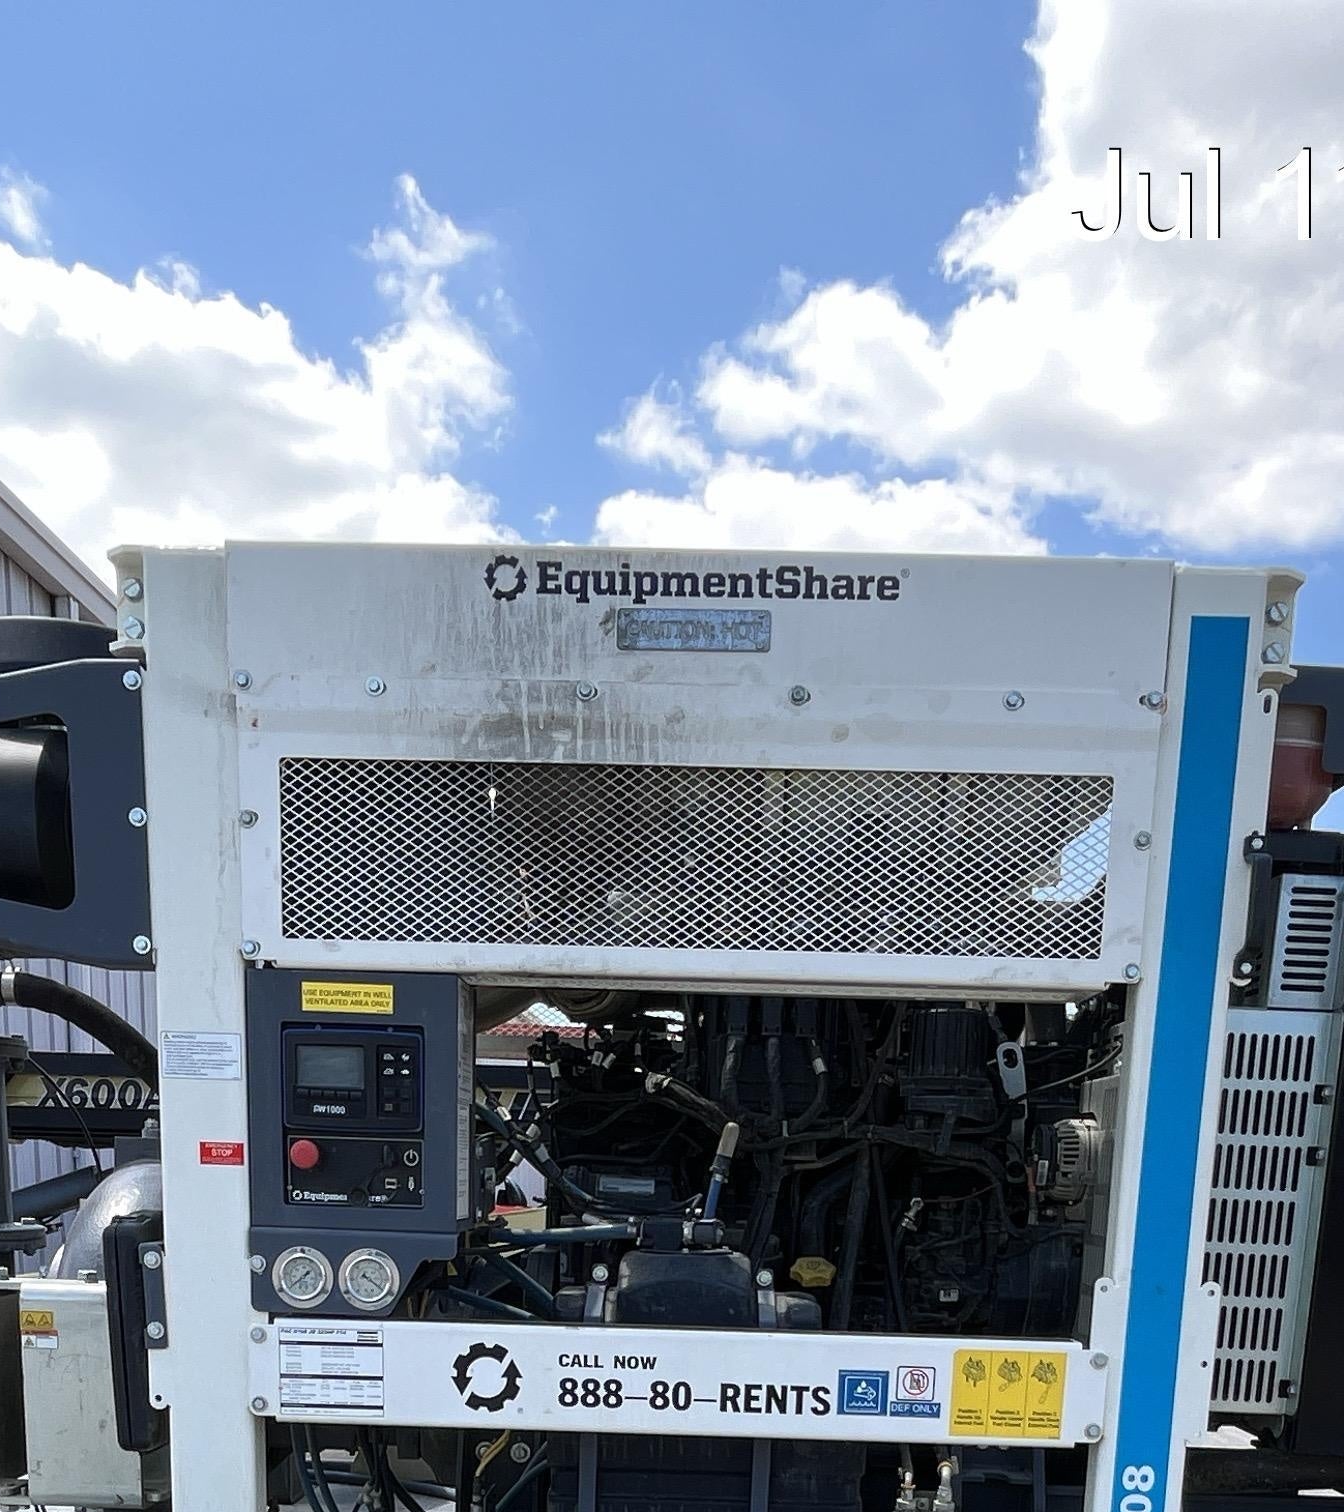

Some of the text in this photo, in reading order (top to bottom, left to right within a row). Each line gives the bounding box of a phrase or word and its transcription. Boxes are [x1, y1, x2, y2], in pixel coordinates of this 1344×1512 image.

[536, 560, 900, 604] EquipmentShare
[319, 989, 361, 998] EQUIPMENT
[304, 998, 348, 1006] VENTILATED
[370, 1000, 390, 1008] ONLY
[211, 1148, 233, 1157] STOP
[558, 1353, 657, 1370] CALL NOW
[891, 1403, 939, 1413] DEF ONLY
